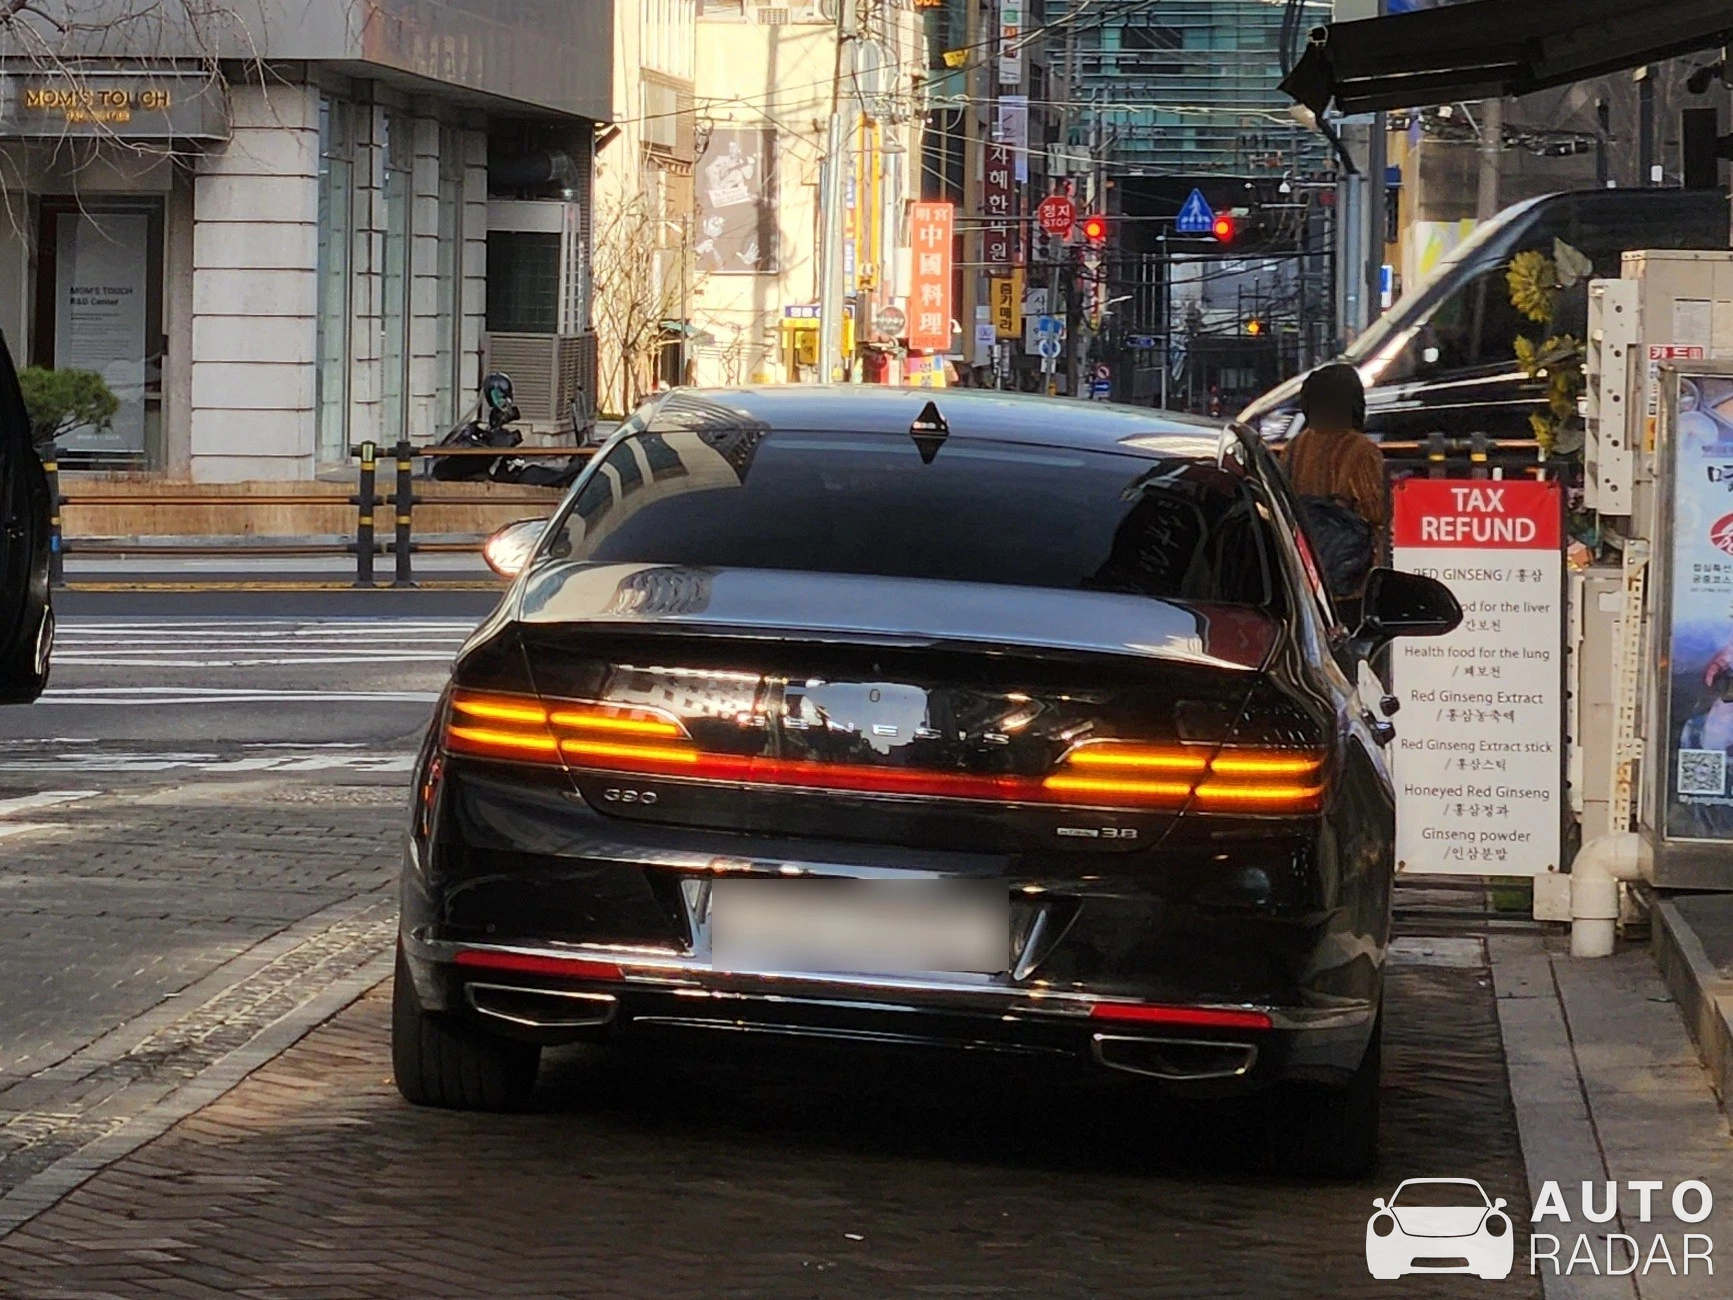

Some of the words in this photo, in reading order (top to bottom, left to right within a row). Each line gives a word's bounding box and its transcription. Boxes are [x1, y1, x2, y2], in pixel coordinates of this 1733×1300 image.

[26, 90, 95, 108] MOM'S
[97, 91, 171, 109] TOUCH
[1043, 203, 1070, 218] 정지
[1043, 218, 1071, 228] STOP
[69, 286, 100, 296] MOM'S
[102, 287, 133, 296] TOUCH
[90, 298, 120, 307] Center
[1451, 487, 1505, 513] TAX
[1421, 516, 1537, 543] REFUND
[1442, 567, 1503, 582] GINSENG
[1515, 567, 1543, 583] 홍삼
[1479, 599, 1497, 613] for
[1500, 601, 1520, 613] the
[1523, 601, 1551, 613] liver
[1404, 645, 1445, 659] Health
[1447, 646, 1476, 659] food
[1479, 646, 1497, 659] for
[1499, 647, 1520, 659] the
[1522, 647, 1551, 662] lung
[1411, 689, 1436, 702] Red
[1439, 690, 1494, 706] Ginseng
[1496, 691, 1544, 705] Extract
[1400, 738, 1424, 750] Red
[1426, 739, 1475, 753] Ginseng
[1479, 739, 1522, 752] Extract
[1524, 740, 1553, 753] stick
[603, 787, 658, 805] G90
[1404, 784, 1463, 800] Honeyed
[1466, 785, 1492, 798] Red
[1495, 785, 1551, 803] Ginseng
[1421, 827, 1476, 843] Ginseng
[1479, 829, 1532, 843] powder
